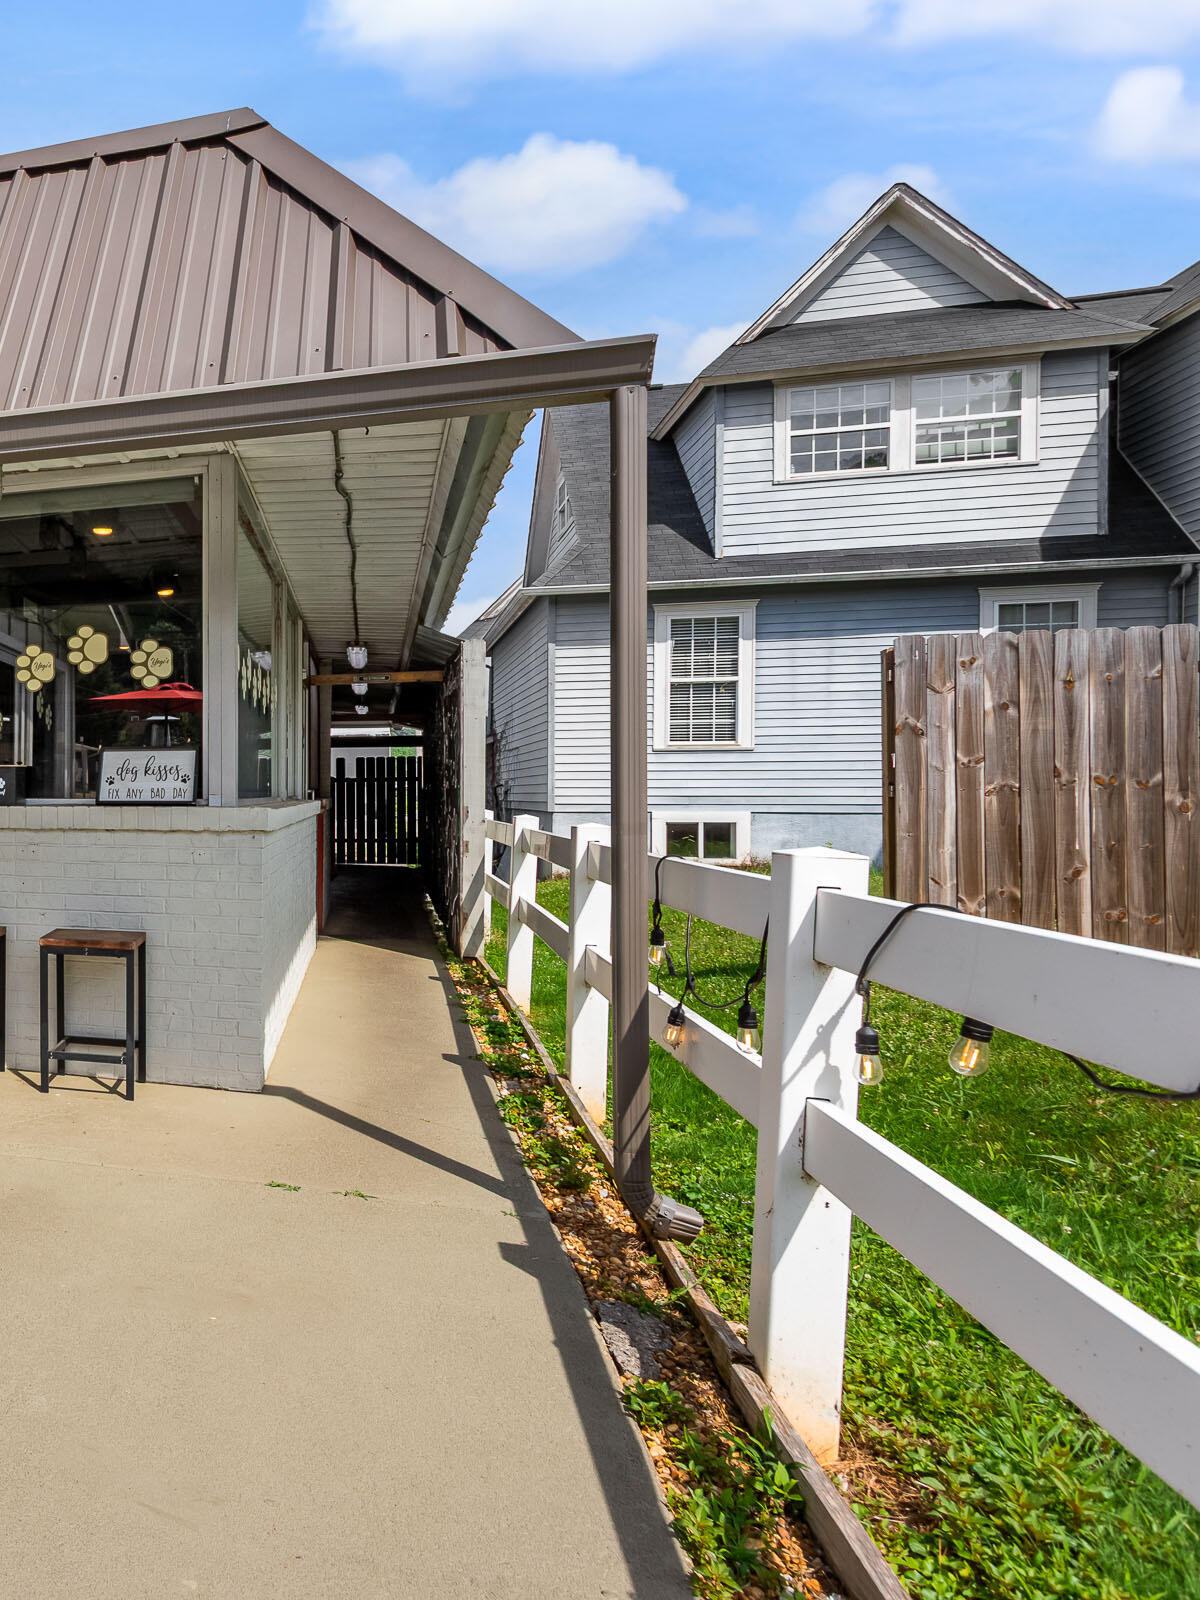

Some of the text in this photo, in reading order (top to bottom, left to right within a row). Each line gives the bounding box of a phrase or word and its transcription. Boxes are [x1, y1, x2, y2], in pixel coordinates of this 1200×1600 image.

[116, 755, 182, 783] dog kisses
[108, 787, 188, 800] FIX ANY BAD DAY
